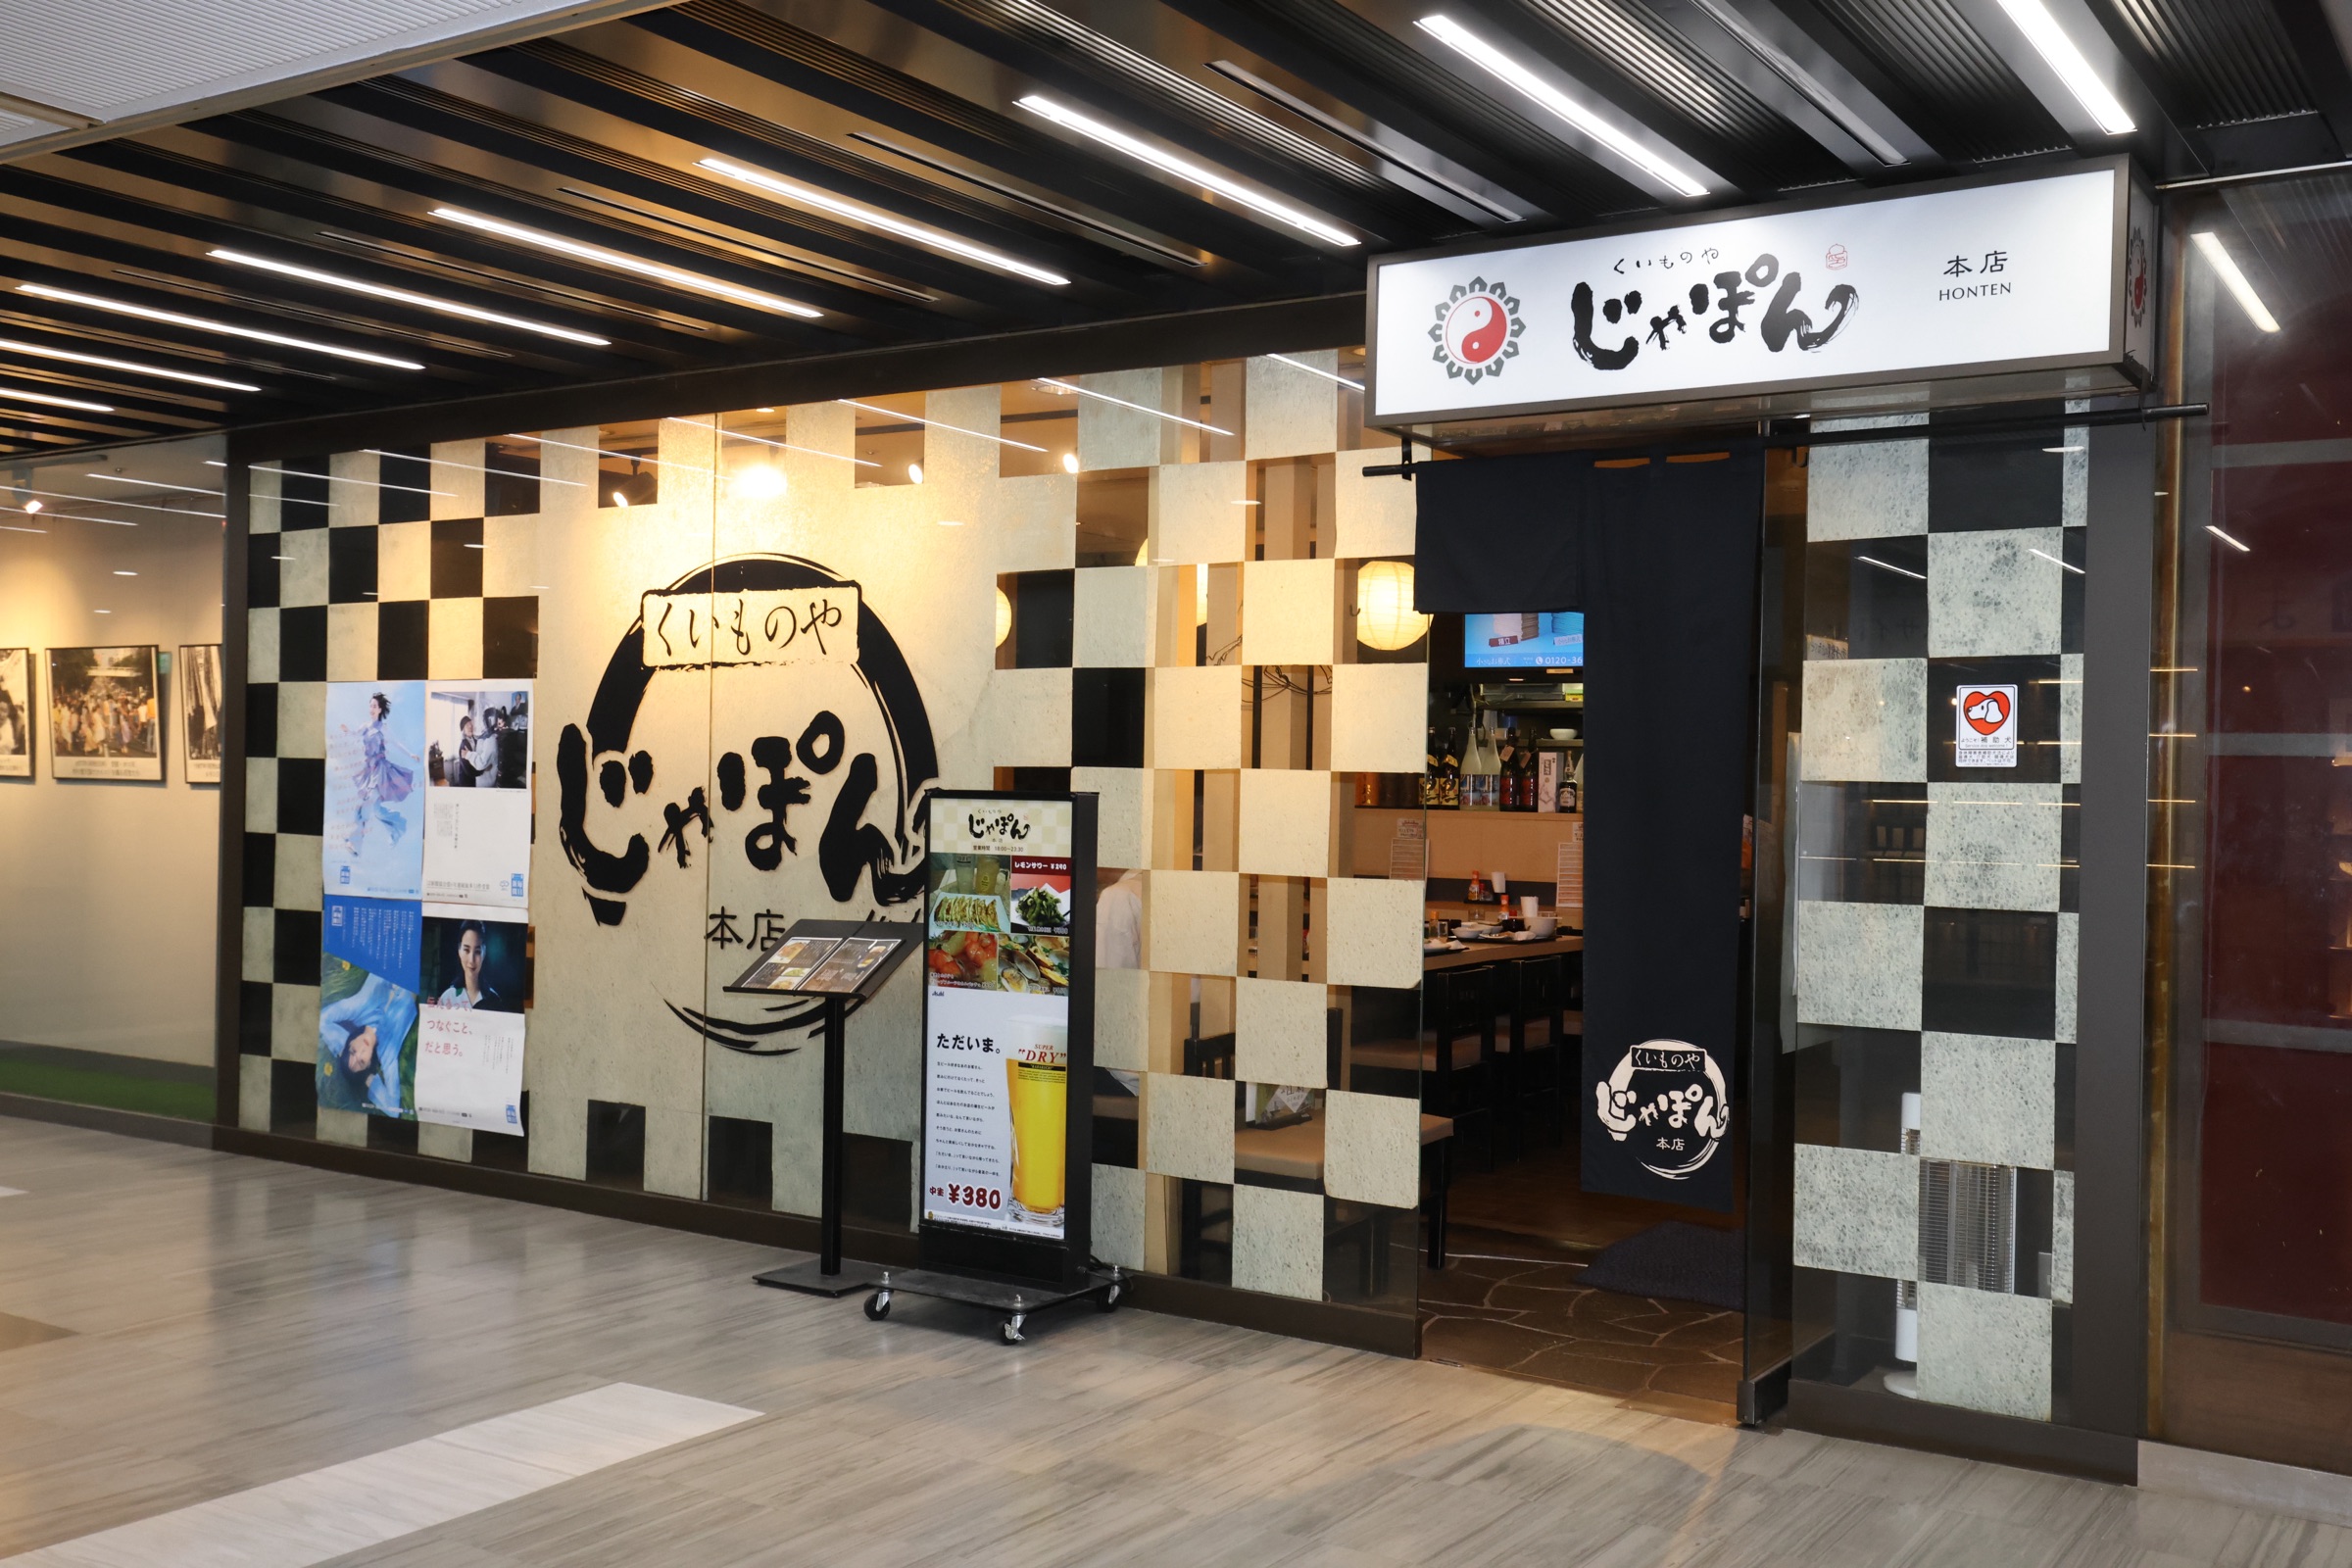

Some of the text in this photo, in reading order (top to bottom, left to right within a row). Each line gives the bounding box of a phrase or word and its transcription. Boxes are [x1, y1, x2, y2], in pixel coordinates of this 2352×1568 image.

[1613, 247, 1719, 274] くいものや
[1943, 250, 2008, 277] 本店
[1938, 282, 2011, 301] HONTEN
[1571, 253, 1859, 370] じゃぽん
[657, 599, 842, 656] くいものや
[1544, 656, 1583, 664] 0120-36
[557, 710, 927, 907] じゃぽん
[968, 812, 1031, 840] じゃぽん
[705, 906, 785, 951] 本店
[426, 1019, 472, 1035] つなぐこと、
[424, 1041, 463, 1057] だと思う。
[937, 1033, 1001, 1054] ただいま。
[1635, 1050, 1700, 1069] くいものや
[1595, 1081, 1730, 1137] じゃぽん
[1656, 1137, 1686, 1151] 本店
[948, 1183, 1002, 1210] ¥380
